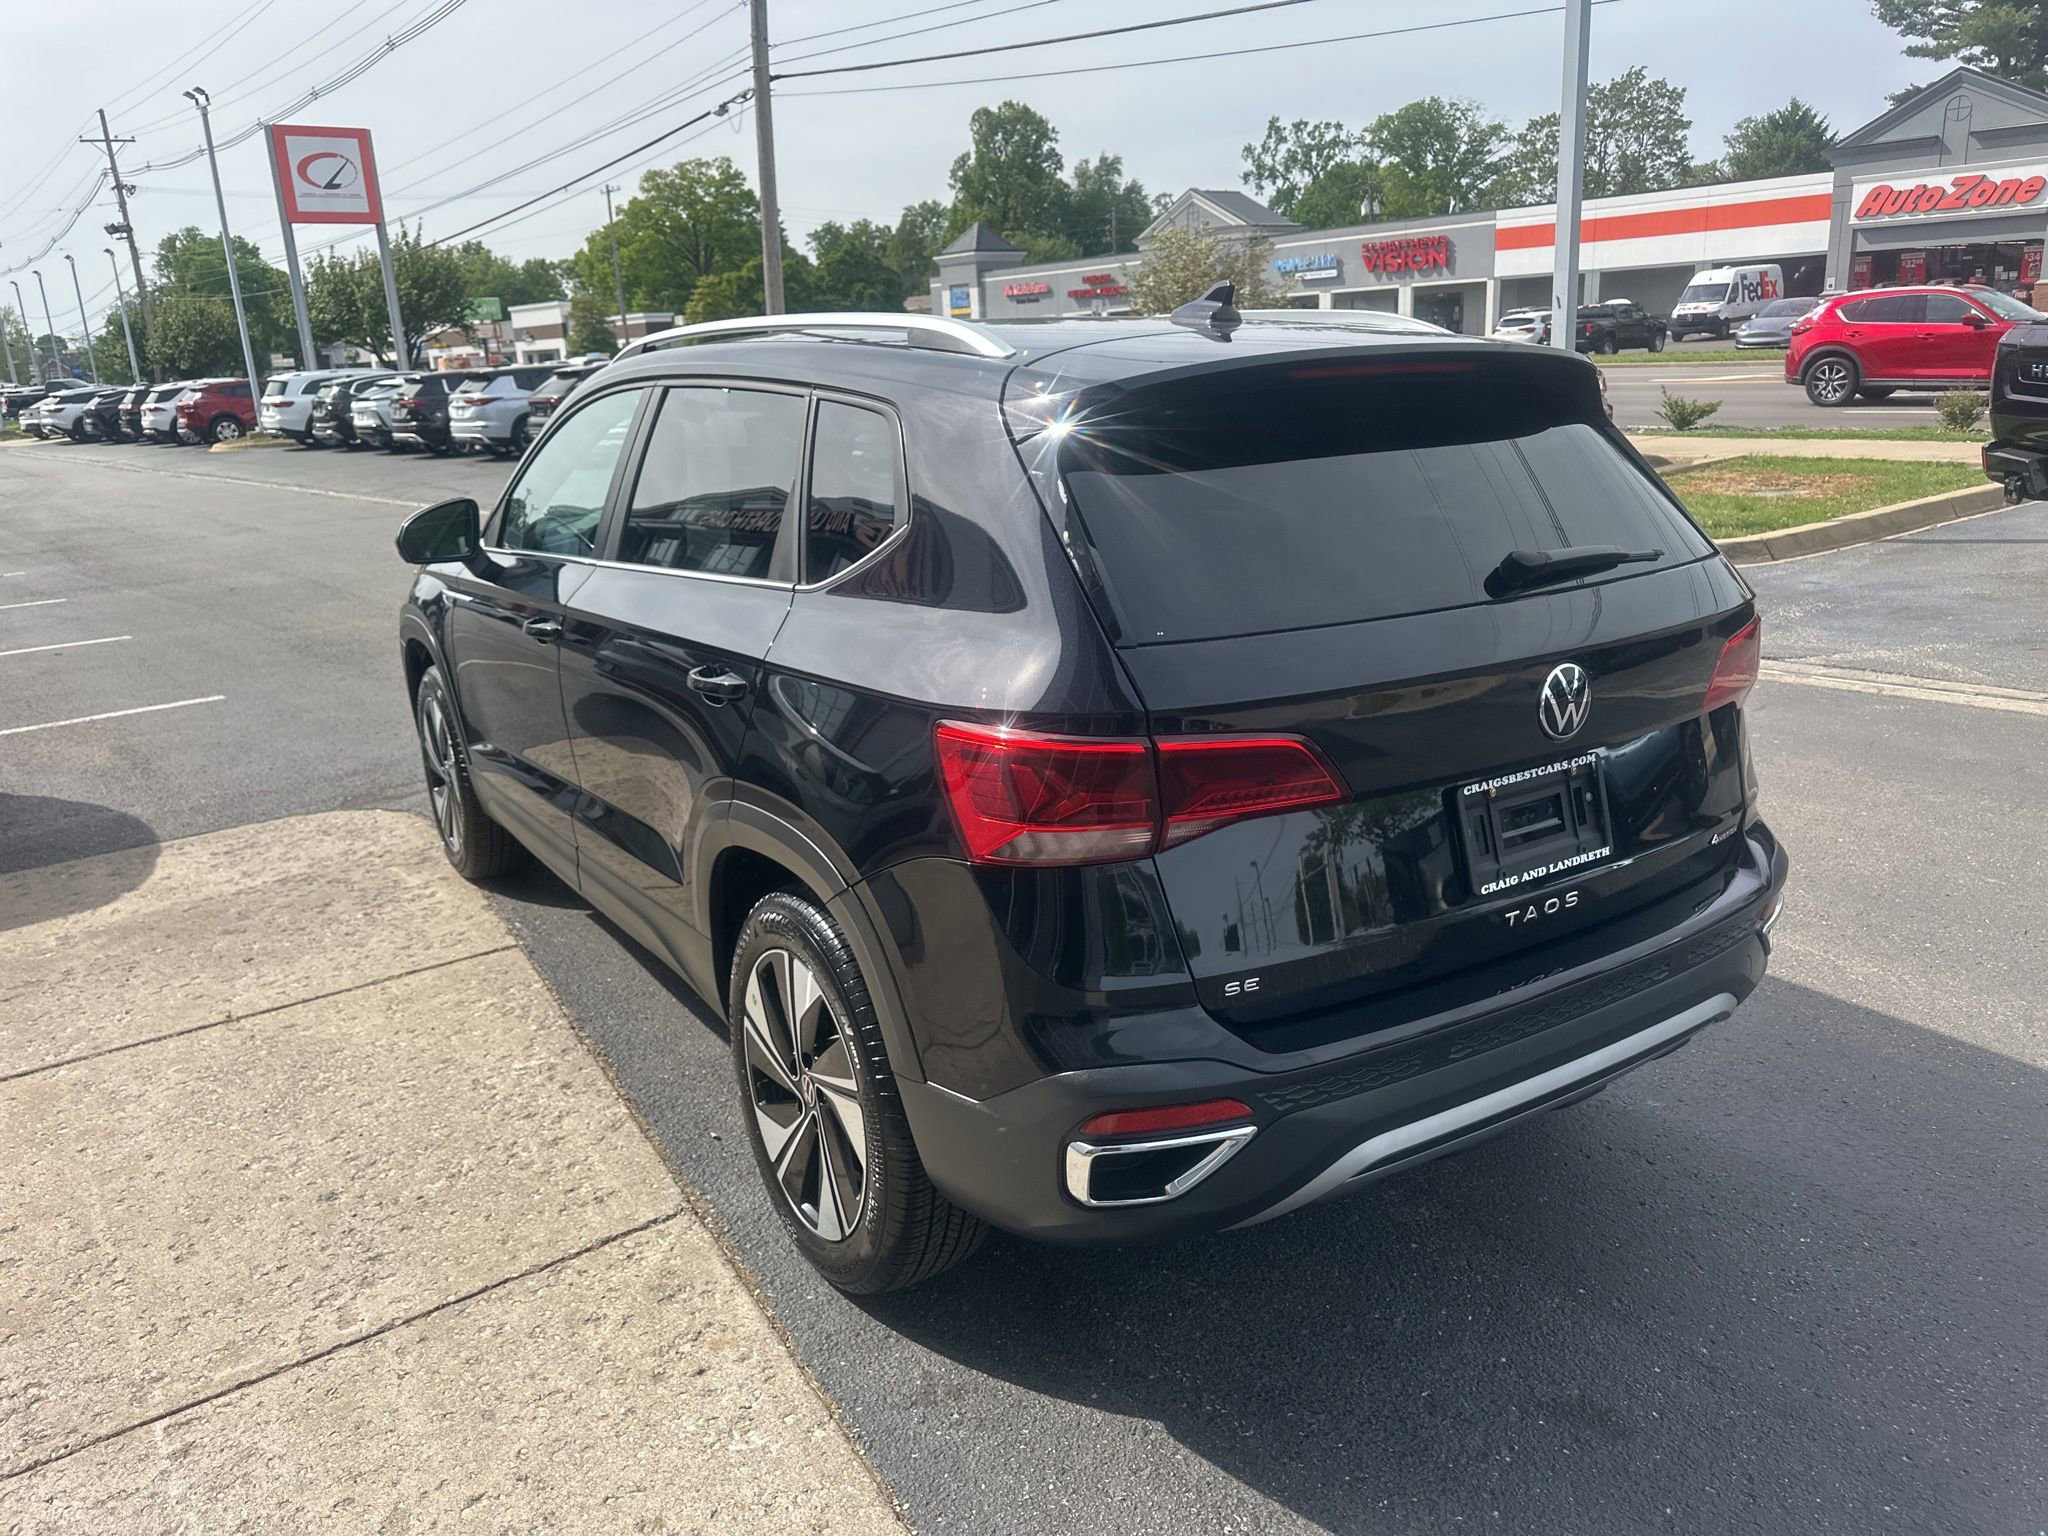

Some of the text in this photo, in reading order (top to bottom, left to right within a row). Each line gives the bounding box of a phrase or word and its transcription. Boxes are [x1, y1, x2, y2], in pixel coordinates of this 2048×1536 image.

[1855, 174, 2048, 218] AutoZone
[1362, 247, 1448, 272] VISION
[1740, 271, 1779, 303] FedEx
[1463, 753, 1597, 796] CRAIGSBESTCARS.COM
[1481, 846, 1610, 895] CRAIG AND LANDRETH
[1505, 890, 1579, 927] TAOS
[1224, 977, 1260, 996] SE
